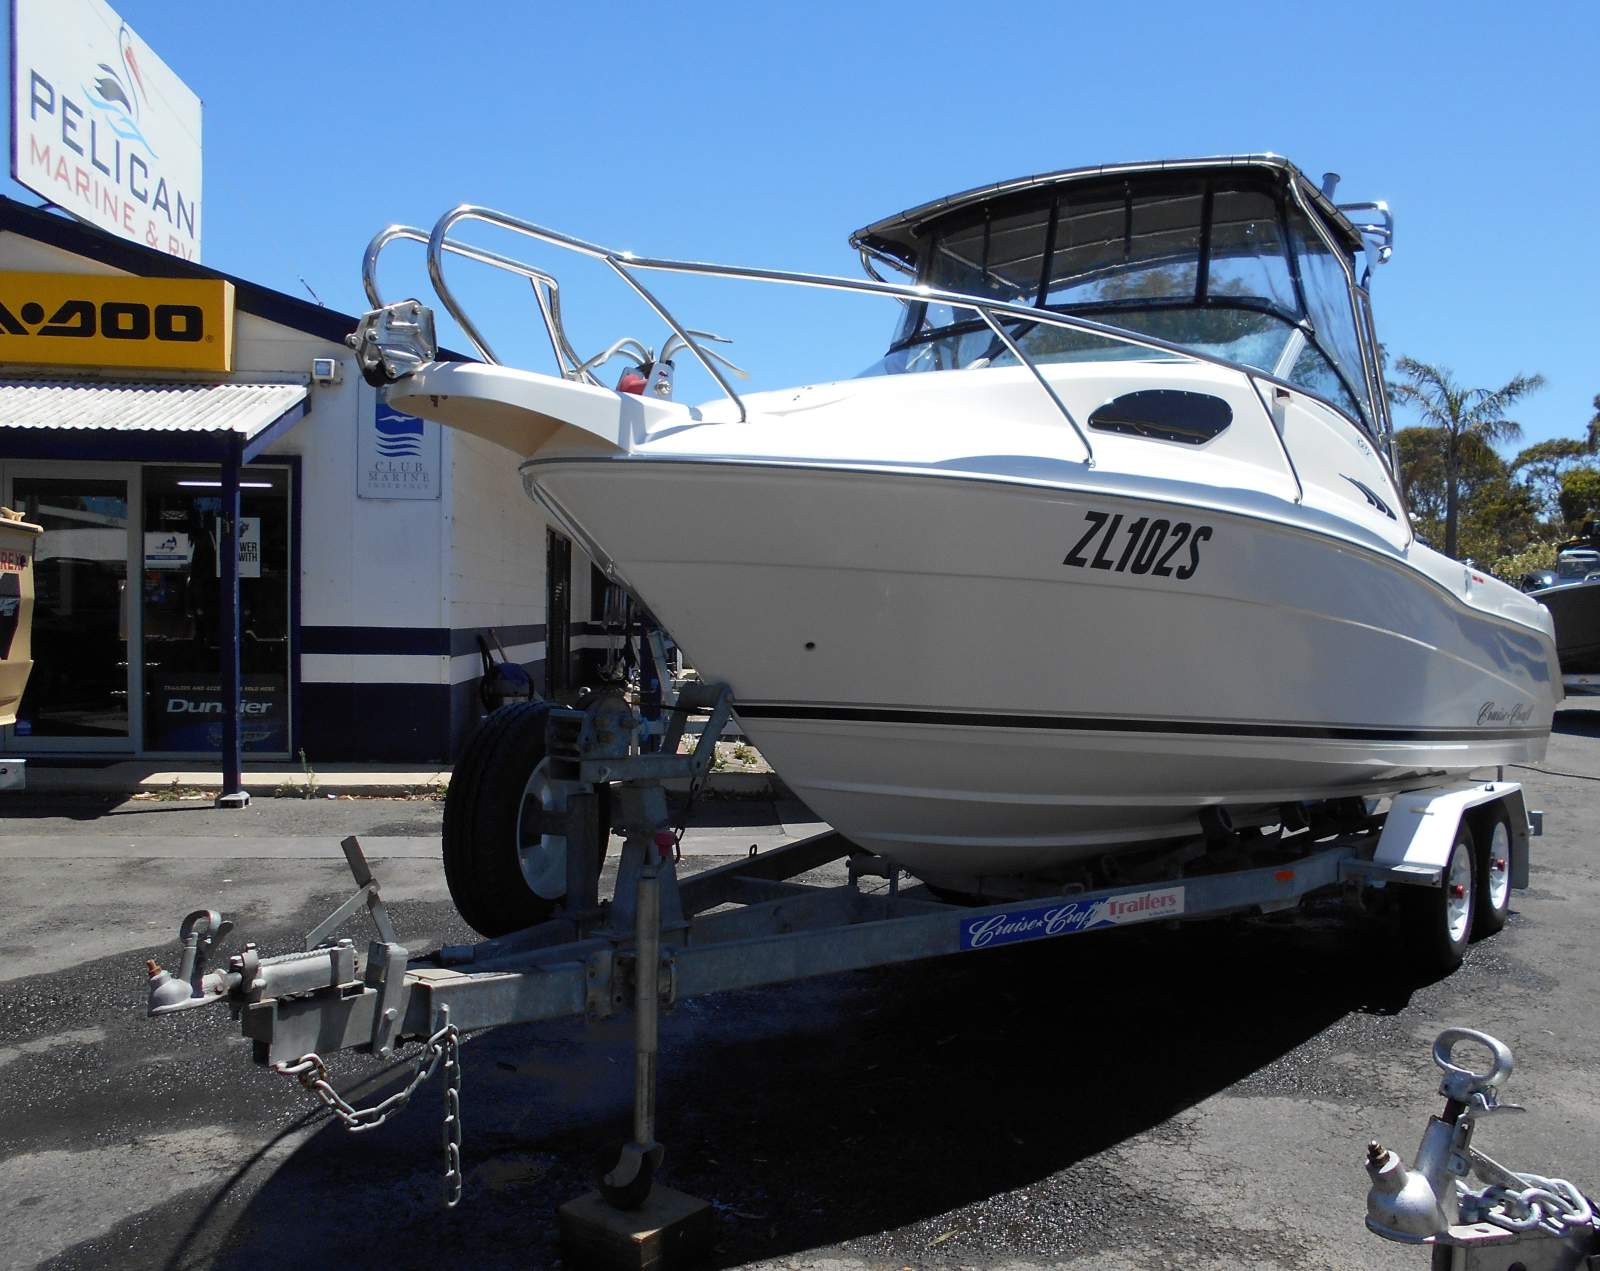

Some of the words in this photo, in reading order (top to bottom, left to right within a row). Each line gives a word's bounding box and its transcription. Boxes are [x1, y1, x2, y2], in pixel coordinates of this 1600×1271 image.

[30, 67, 195, 240] PELICAN
[30, 133, 136, 235] MARINE
[144, 219, 159, 249] &
[368, 472, 430, 482] MARINE
[375, 461, 423, 472] CLUB
[1062, 510, 1214, 580] ZL102S
[167, 699, 272, 713] Dunier
[969, 915, 1038, 948] Cruise
[1109, 894, 1177, 916] Trailers
